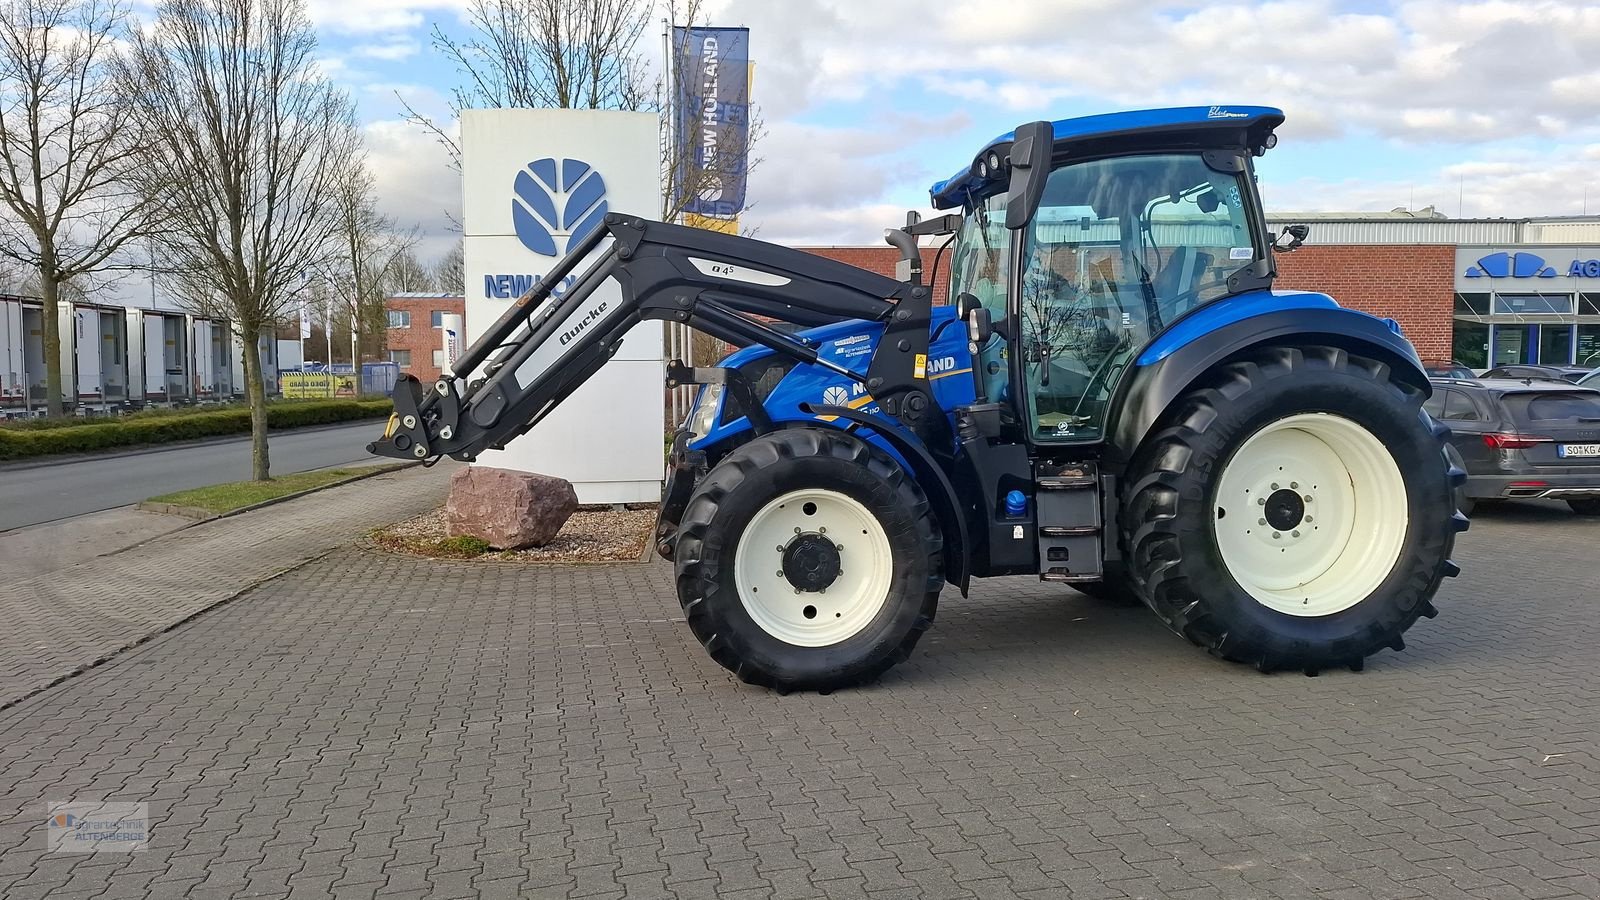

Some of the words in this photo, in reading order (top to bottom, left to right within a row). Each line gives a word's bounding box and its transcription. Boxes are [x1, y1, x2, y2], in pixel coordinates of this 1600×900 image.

[703, 37, 718, 125] HOLLAND
[1568, 259, 1600, 278] AG
[484, 274, 532, 298] NEW
[559, 302, 607, 346] Quicke
[1584, 446, 1596, 454] KG
